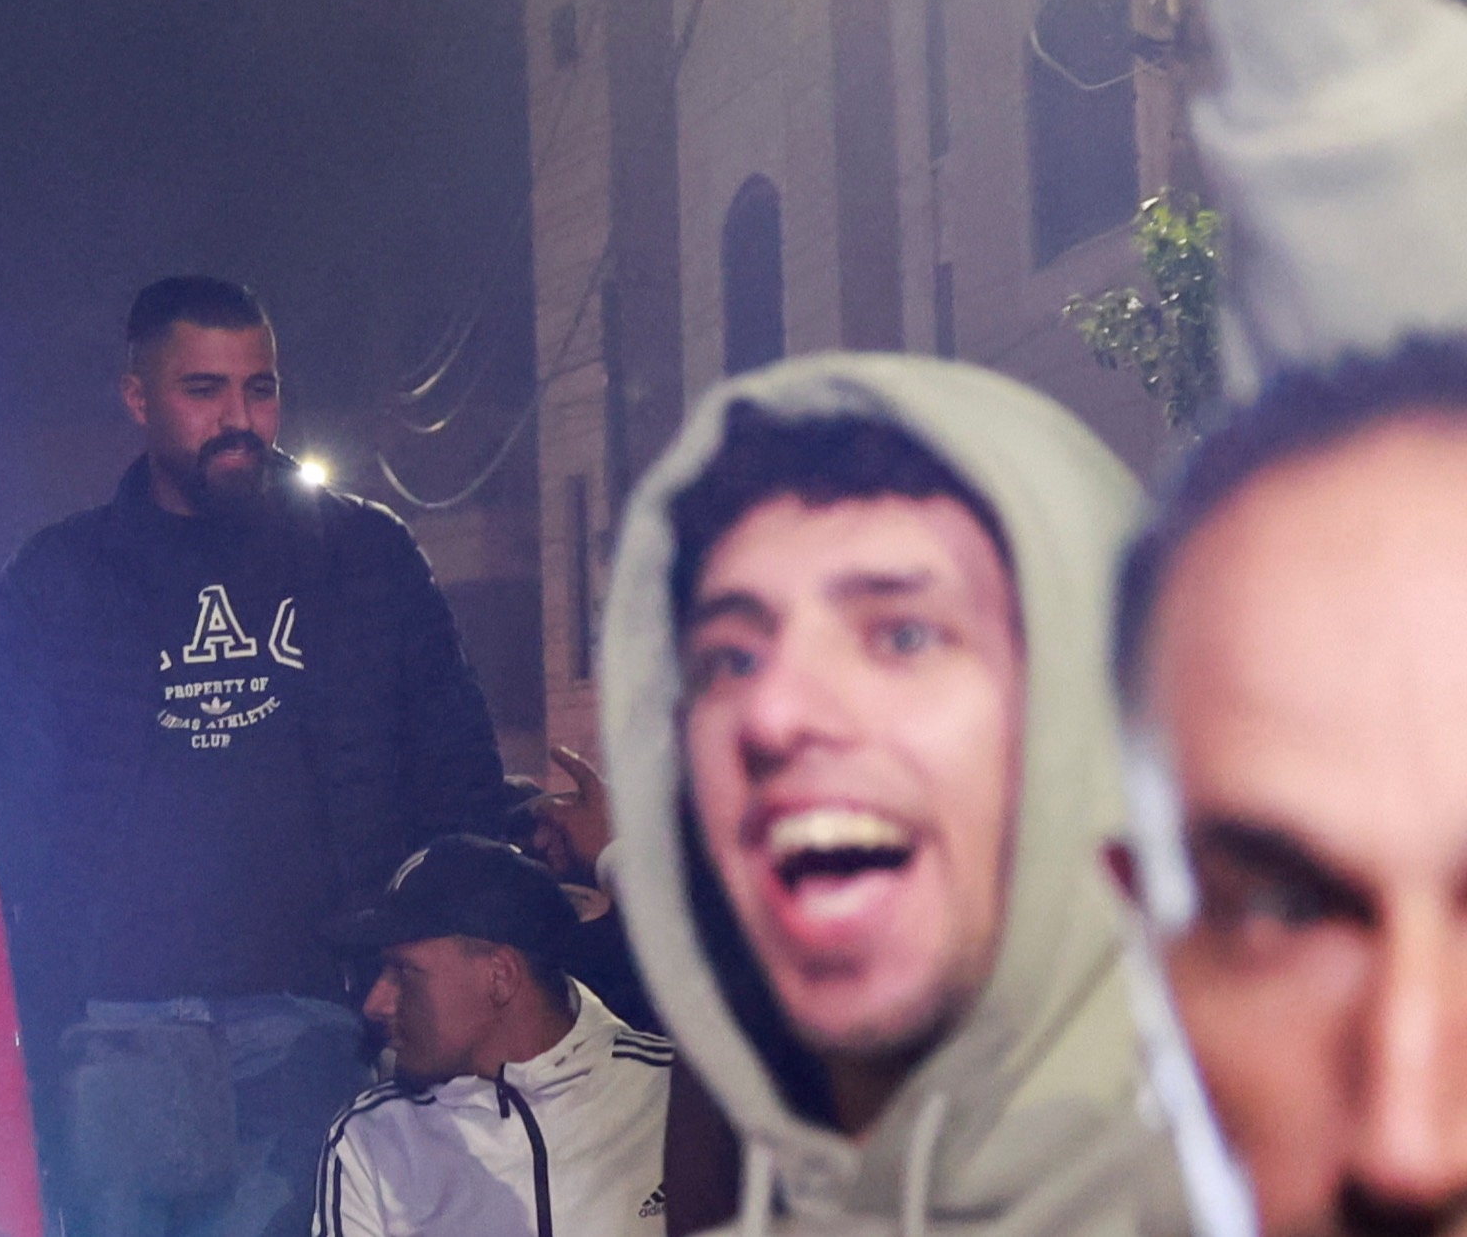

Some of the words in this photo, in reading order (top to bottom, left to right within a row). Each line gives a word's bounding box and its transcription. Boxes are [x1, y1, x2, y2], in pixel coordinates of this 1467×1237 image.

[164, 678, 246, 700] PROPERTY
[250, 677, 269, 693] OF
[191, 733, 231, 750] CLUB
